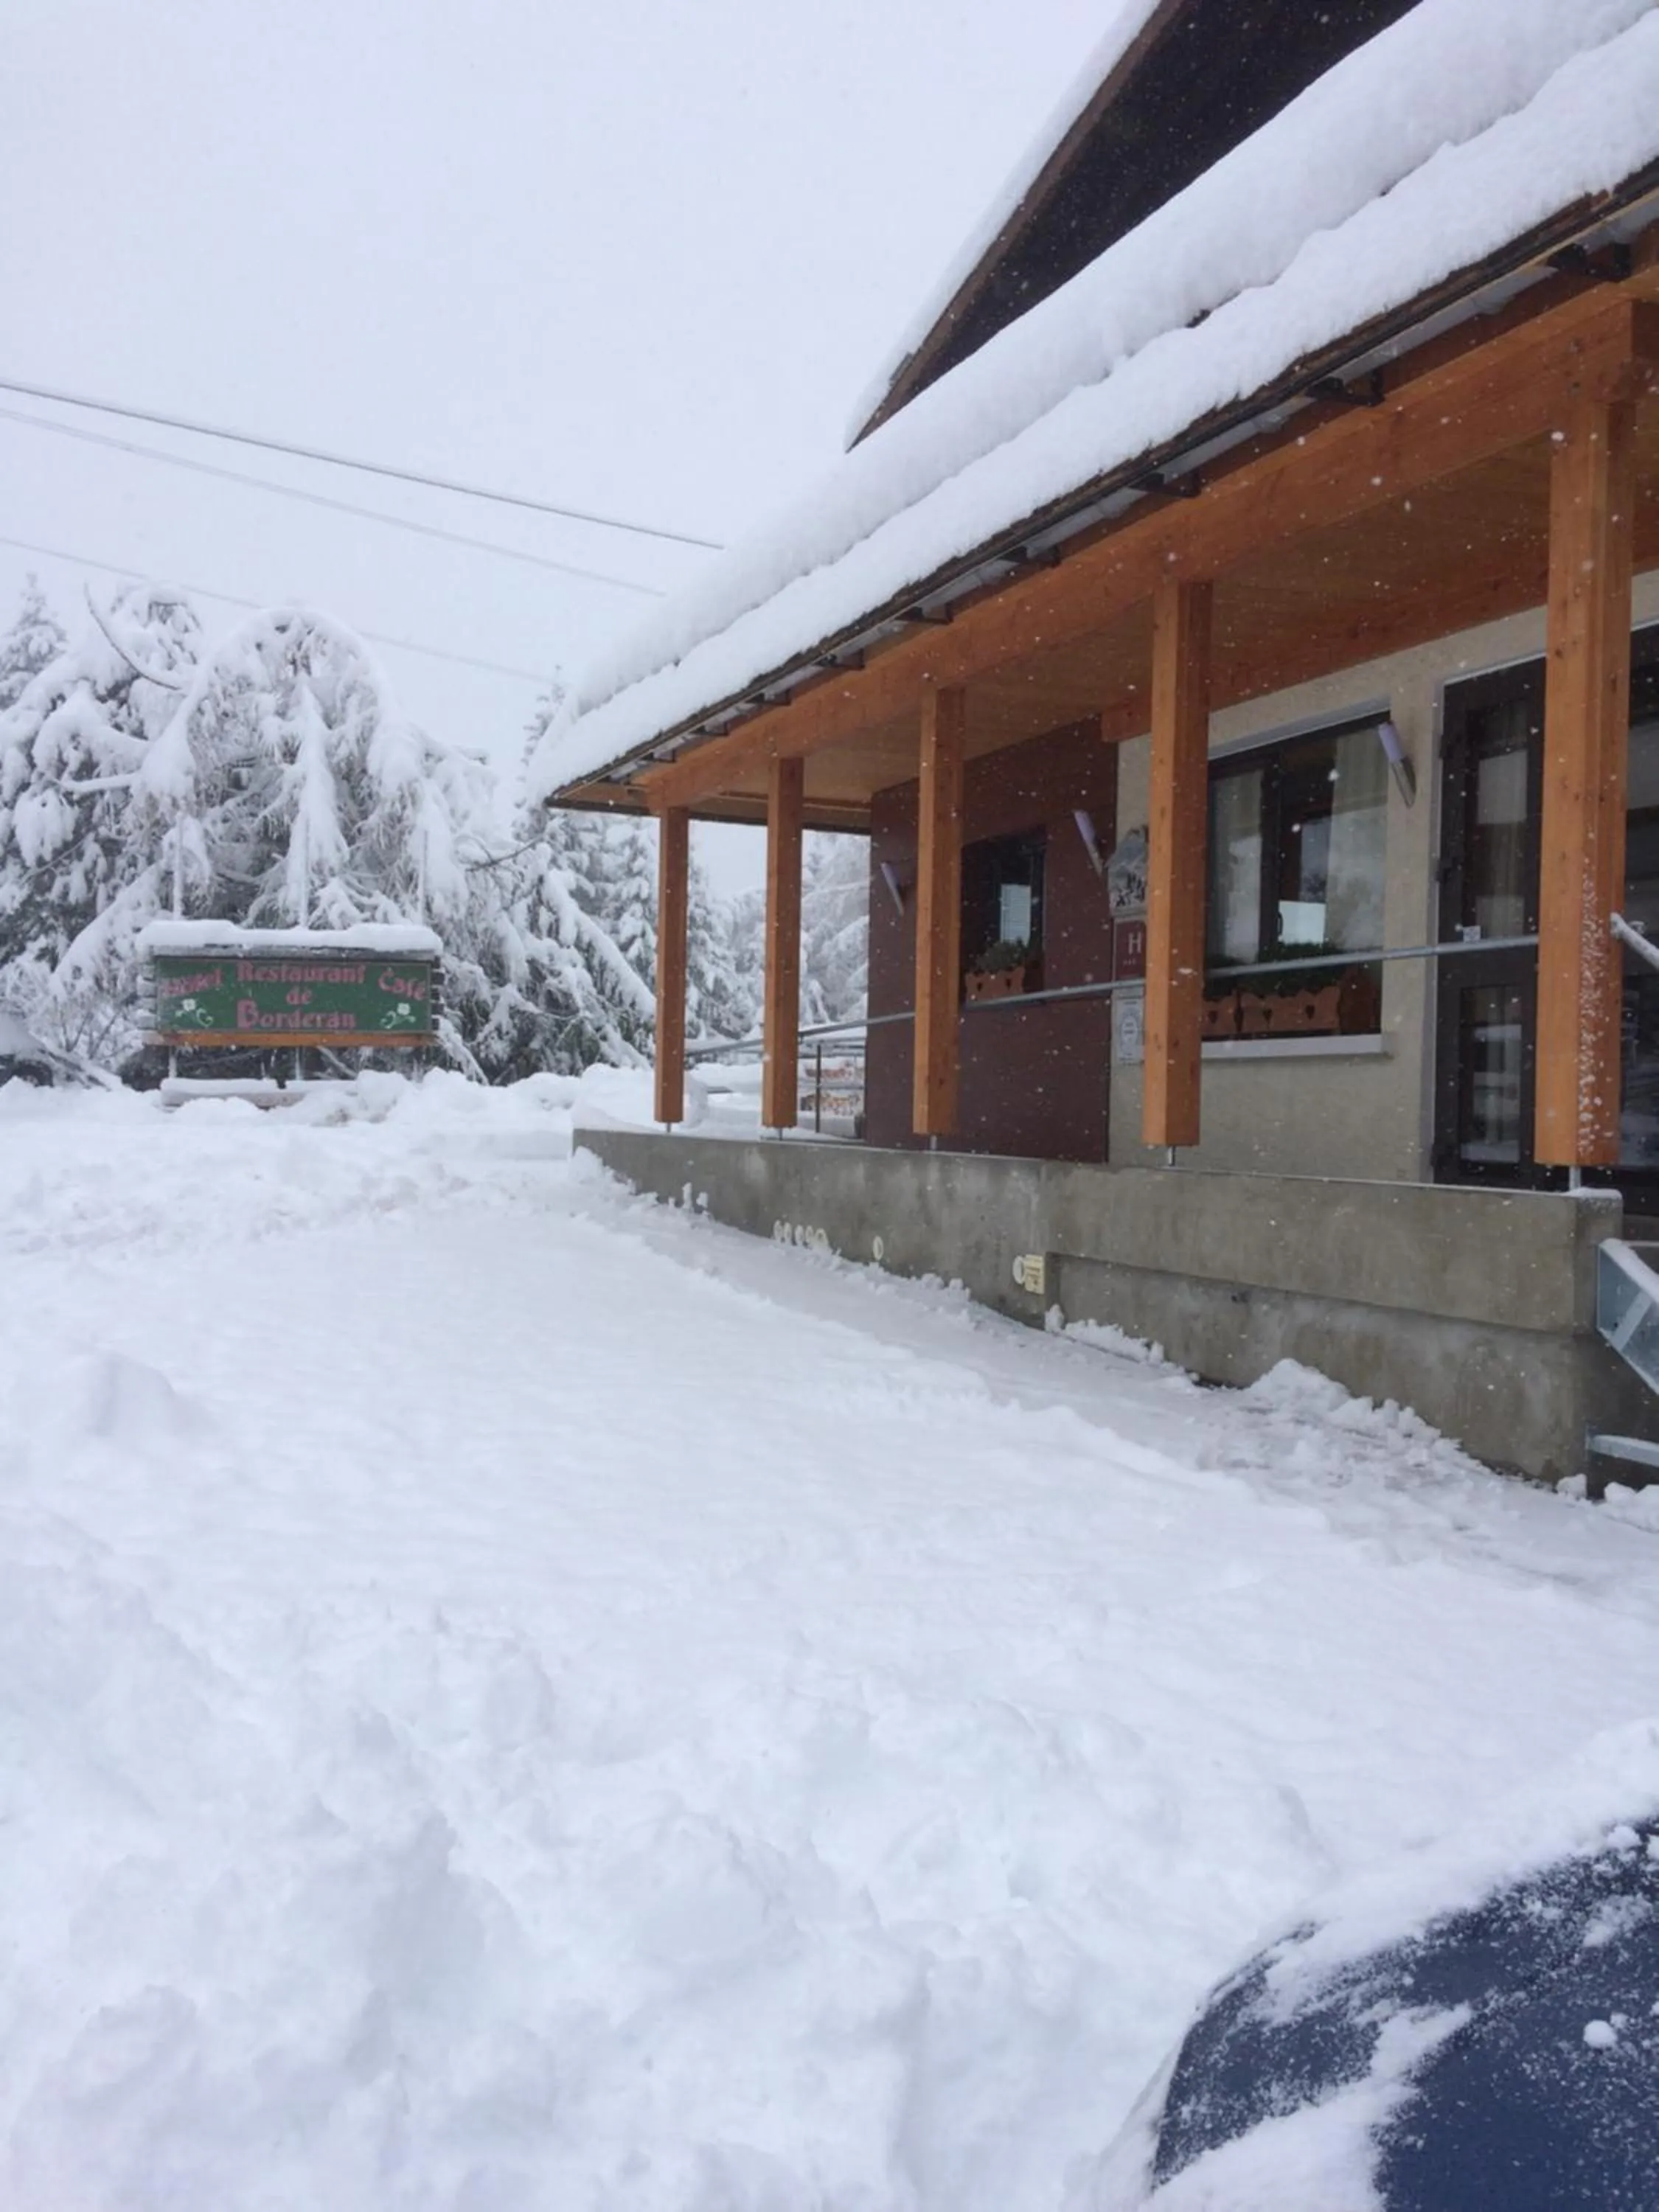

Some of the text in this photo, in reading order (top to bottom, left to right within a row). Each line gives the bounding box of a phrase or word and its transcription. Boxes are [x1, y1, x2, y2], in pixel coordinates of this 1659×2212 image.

[1128, 932, 1141, 955] H
[237, 961, 366, 984] Restaurant
[285, 987, 313, 1005] de
[237, 999, 356, 1029] Borderan
